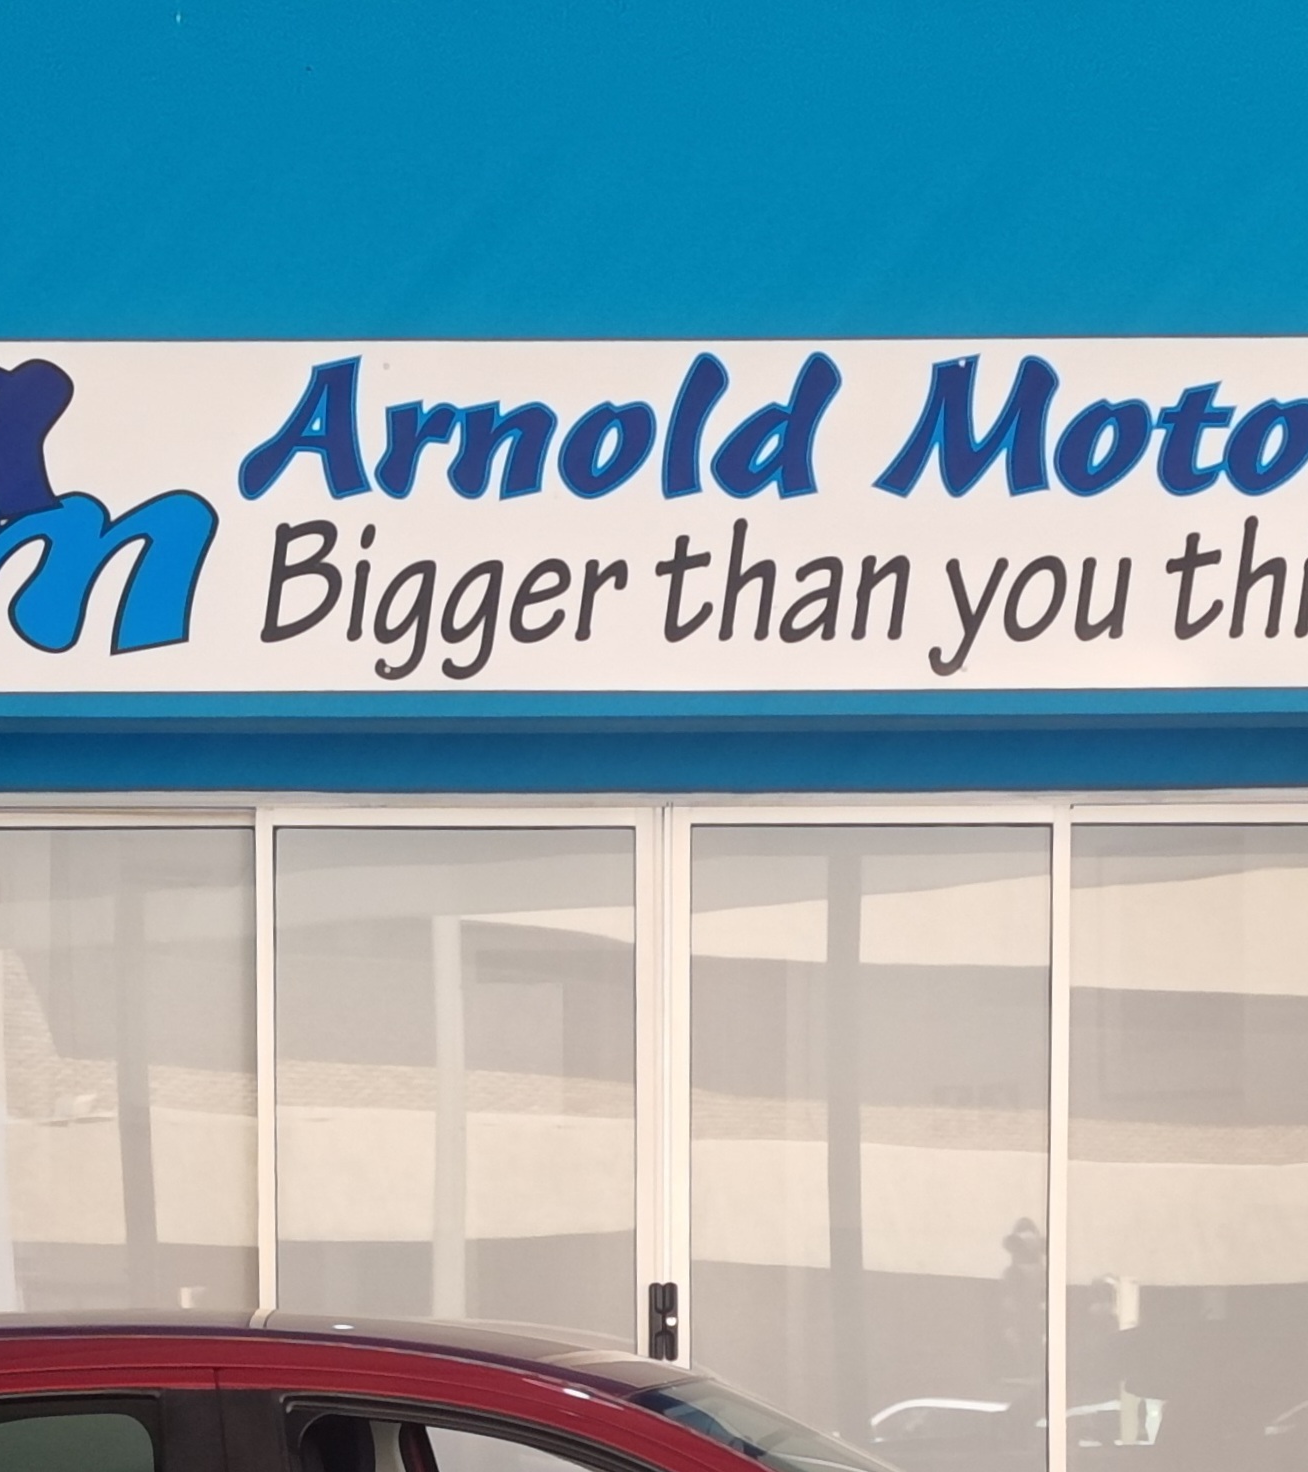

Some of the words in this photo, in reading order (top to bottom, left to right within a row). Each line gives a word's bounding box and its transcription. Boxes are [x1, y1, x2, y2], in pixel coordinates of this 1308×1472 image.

[238, 352, 843, 501] Arnold
[260, 519, 629, 681] Bigger
[655, 517, 911, 644] than
[928, 555, 1132, 677] you
